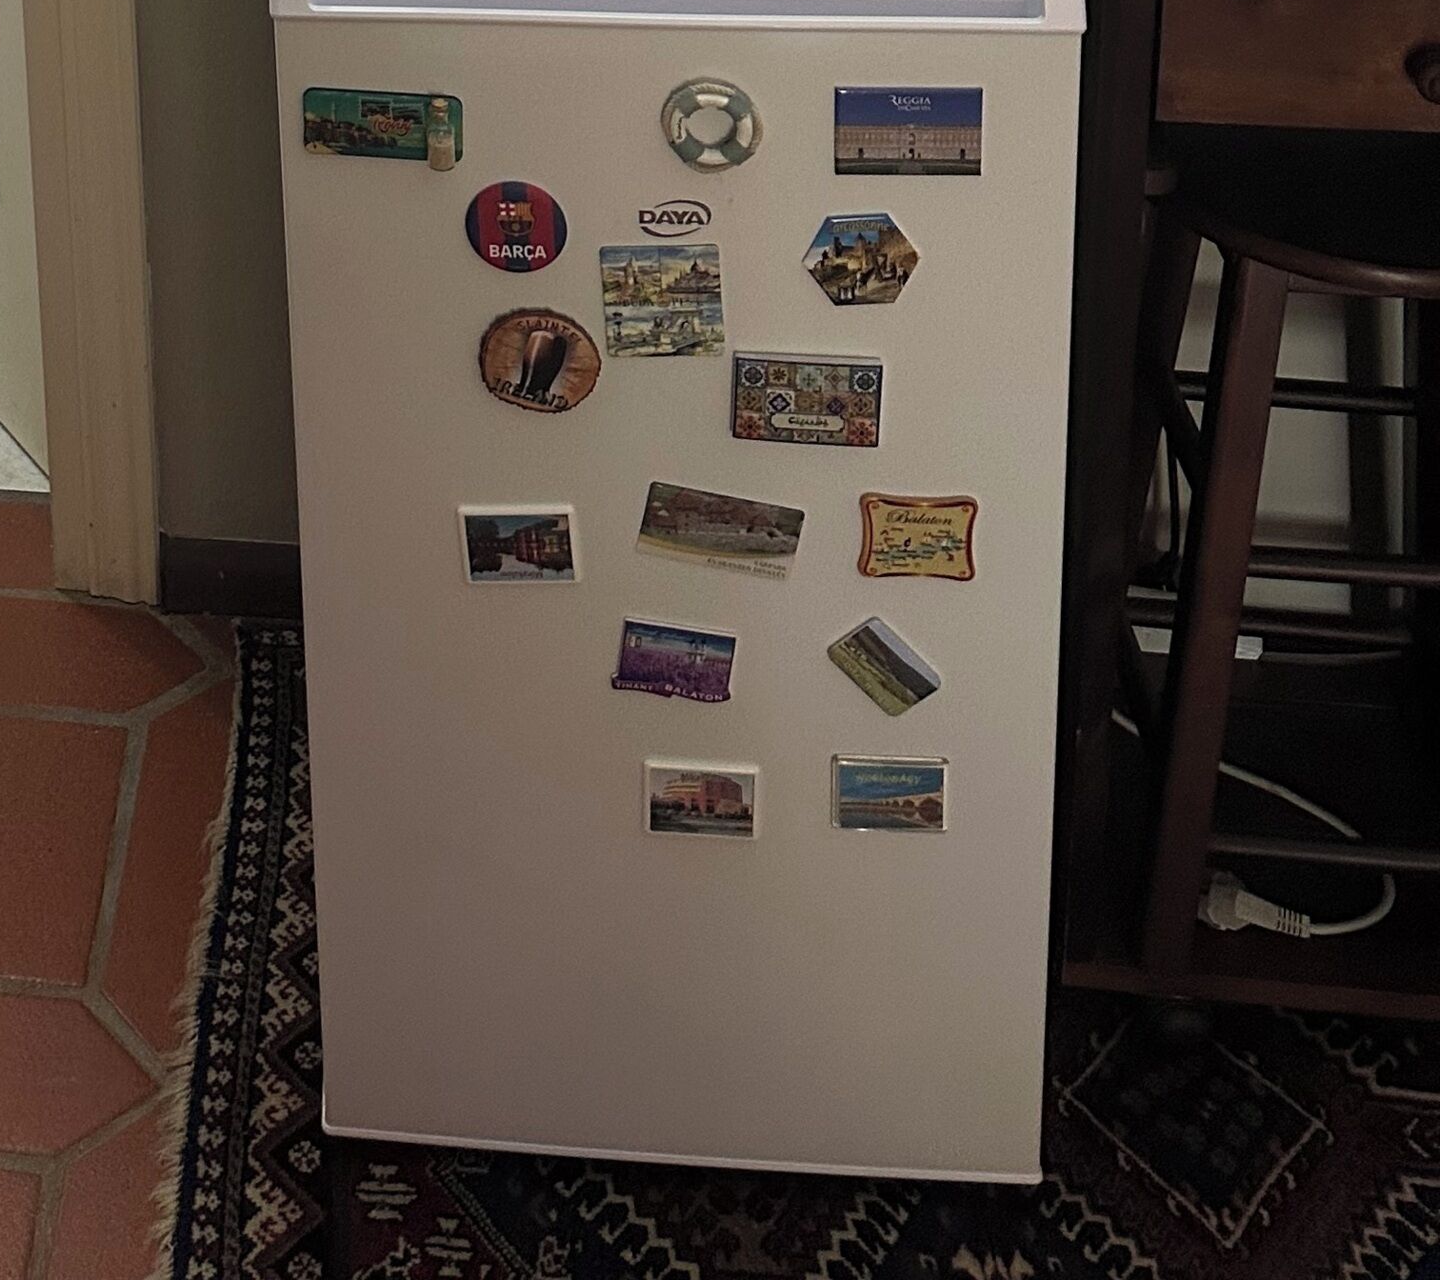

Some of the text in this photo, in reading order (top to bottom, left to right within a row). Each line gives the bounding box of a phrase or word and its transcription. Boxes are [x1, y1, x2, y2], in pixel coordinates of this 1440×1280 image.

[888, 94, 932, 106] REGGIA
[639, 210, 705, 225] DAYA
[489, 244, 547, 260] BARÇA
[491, 378, 569, 409] IRELAND
[885, 508, 953, 525] Balaton
[665, 683, 723, 701] BALATON
